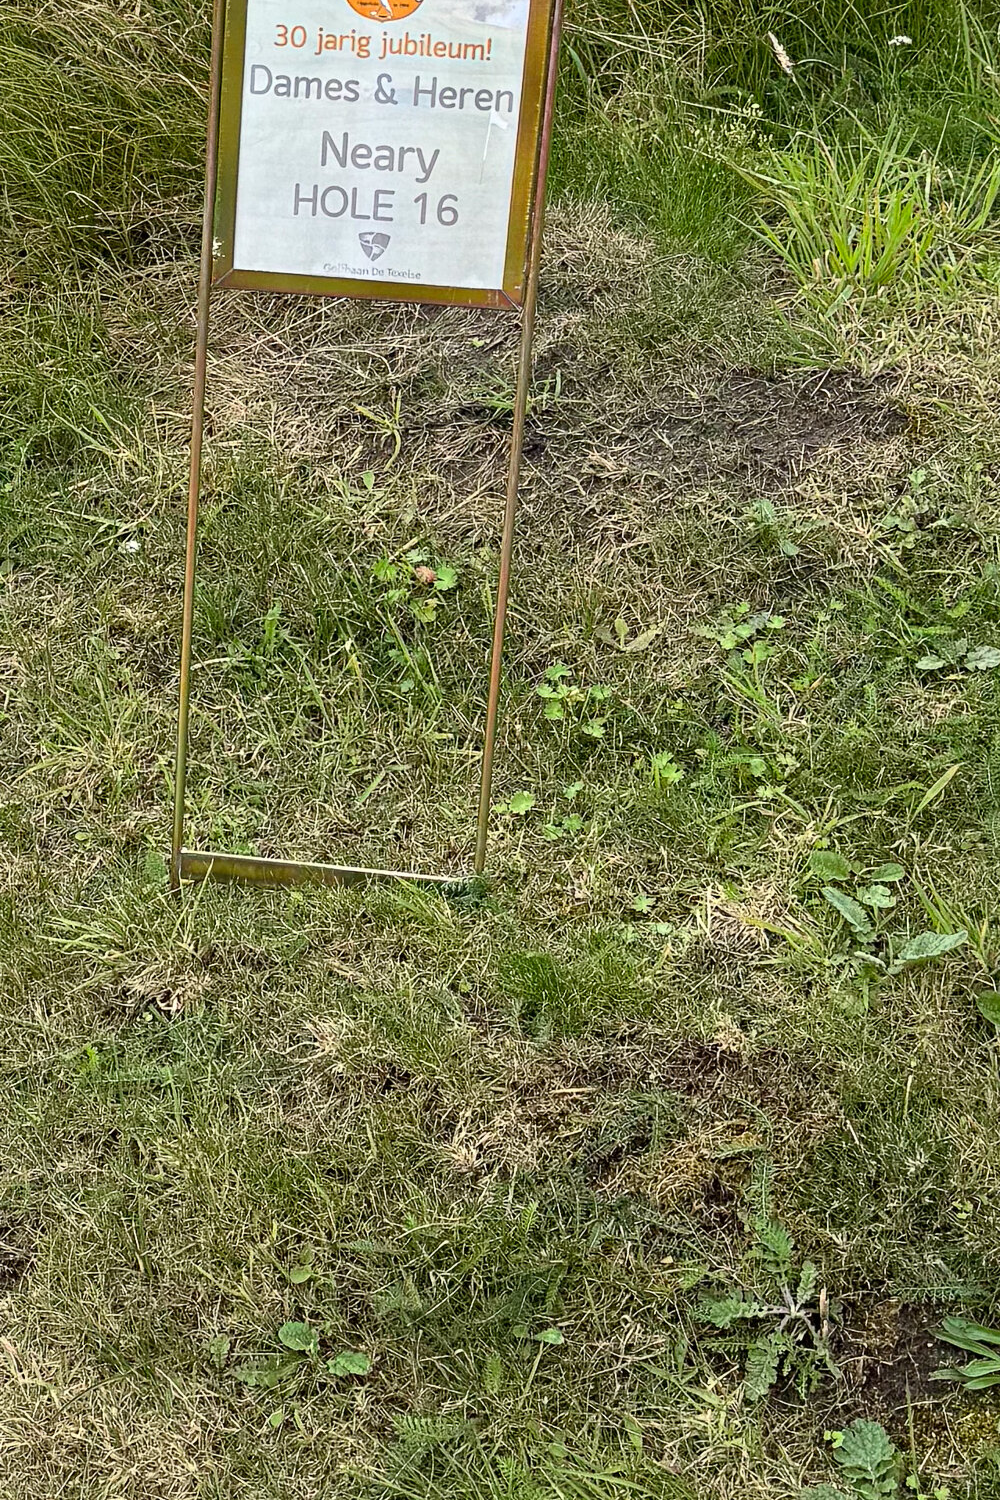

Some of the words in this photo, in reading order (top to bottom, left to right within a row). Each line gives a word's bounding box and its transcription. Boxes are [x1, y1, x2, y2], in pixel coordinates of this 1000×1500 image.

[273, 24, 307, 48] 30
[315, 27, 372, 59] jarig
[379, 31, 493, 62] jubileum!
[250, 64, 360, 102] Dames
[374, 73, 398, 105] &
[413, 75, 514, 113] Heren
[320, 130, 440, 184] Neary
[293, 183, 396, 222] HOLE
[413, 192, 460, 227] 16
[371, 267, 385, 277] De
